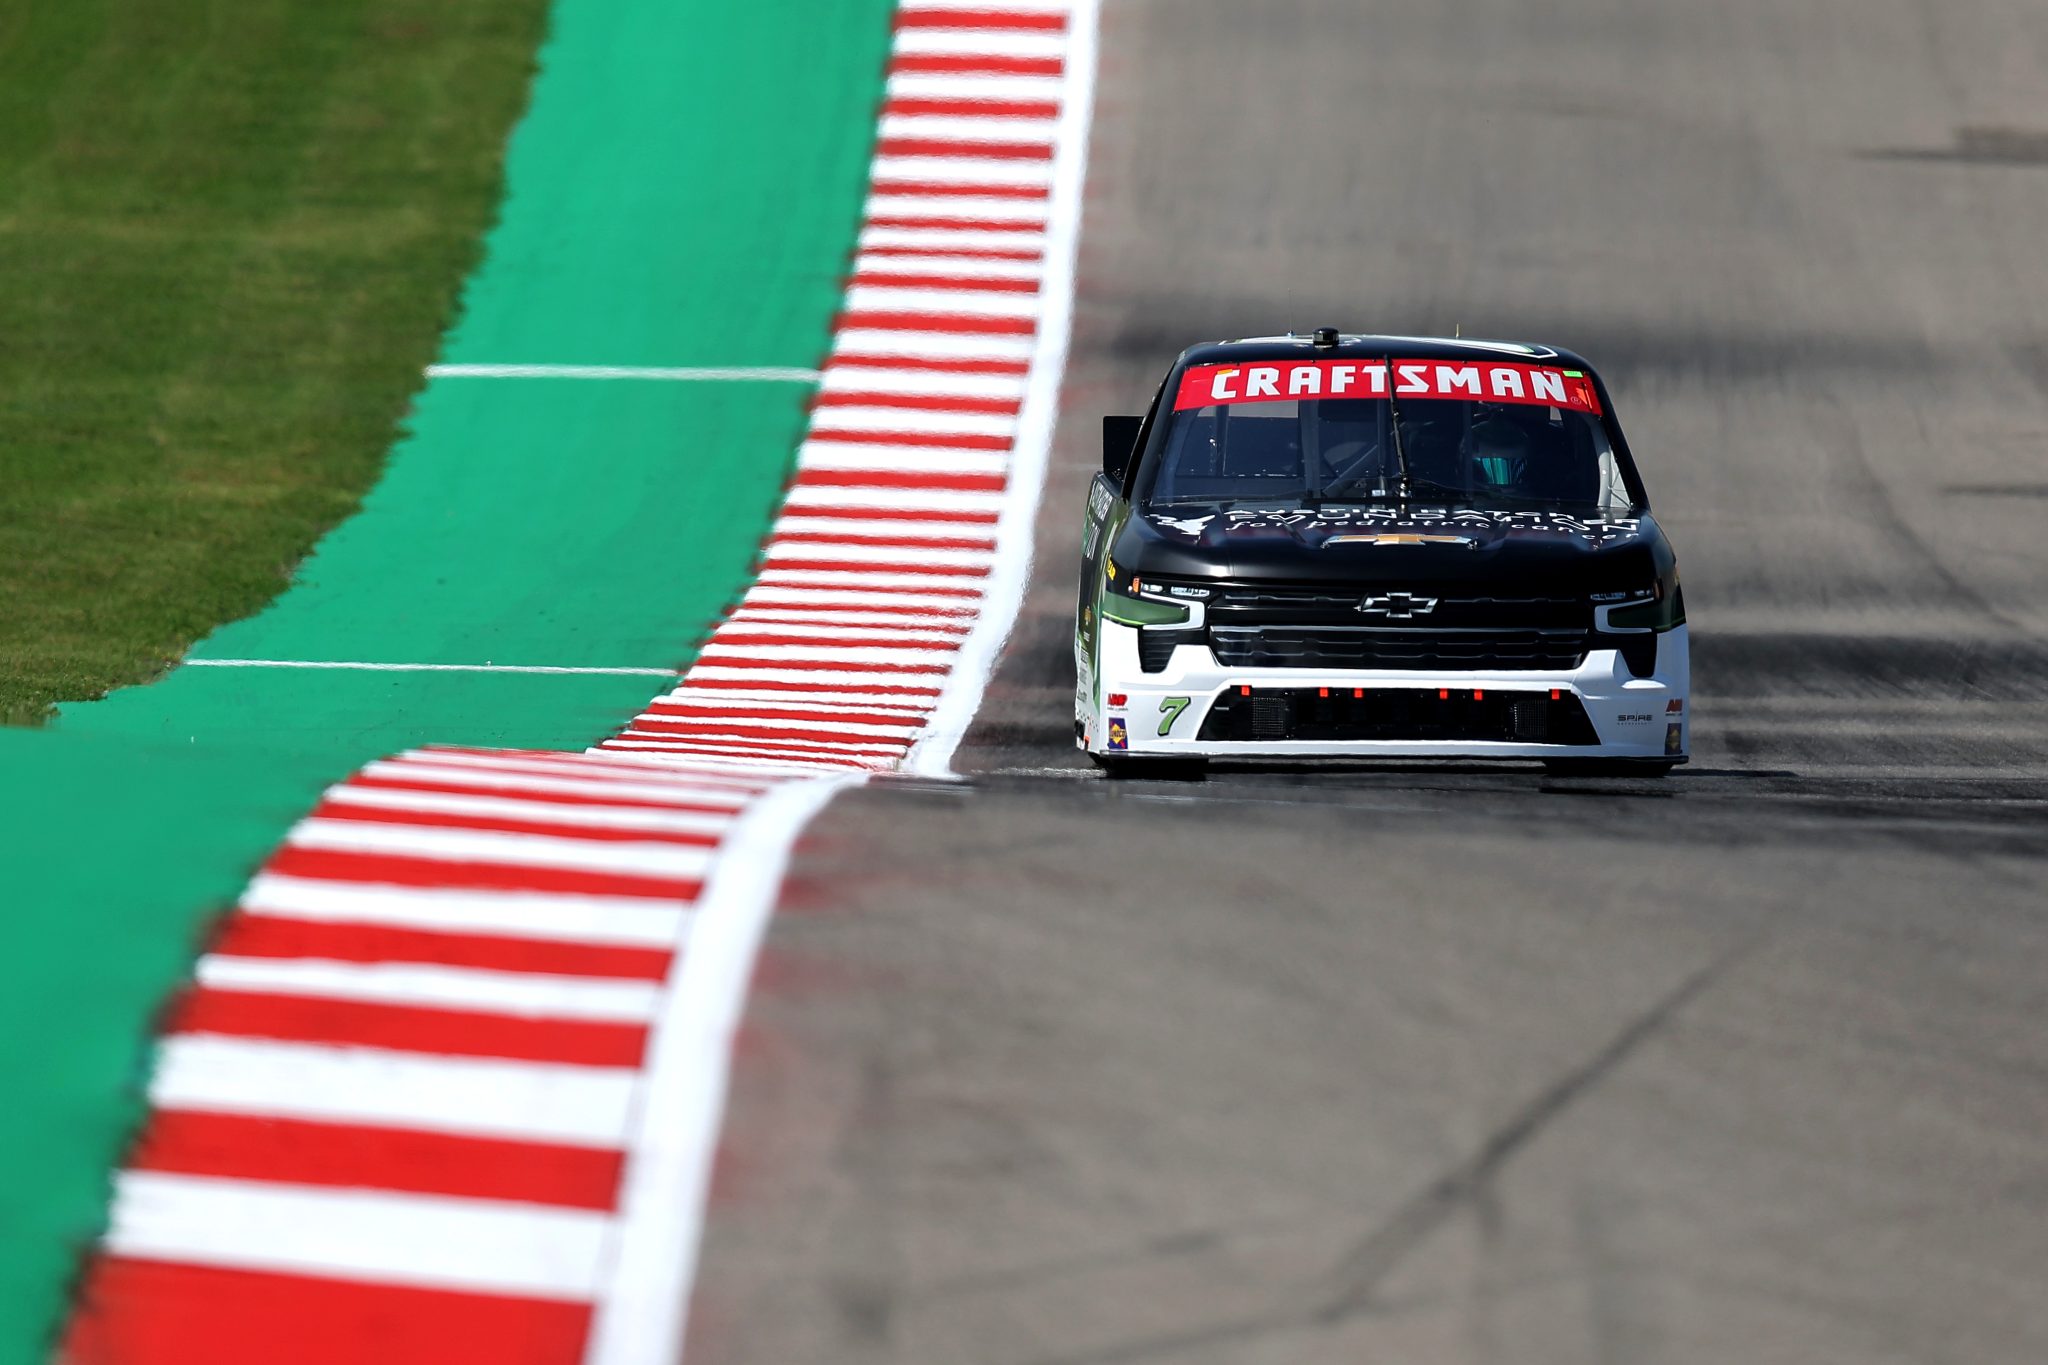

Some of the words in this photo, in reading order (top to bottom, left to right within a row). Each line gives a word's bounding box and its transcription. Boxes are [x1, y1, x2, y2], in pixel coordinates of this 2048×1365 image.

[1211, 366, 1568, 403] CRAFTSMAN
[1304, 519, 1490, 529] pediatric
[1511, 524, 1639, 540] cancer
[1158, 696, 1191, 736] 7
